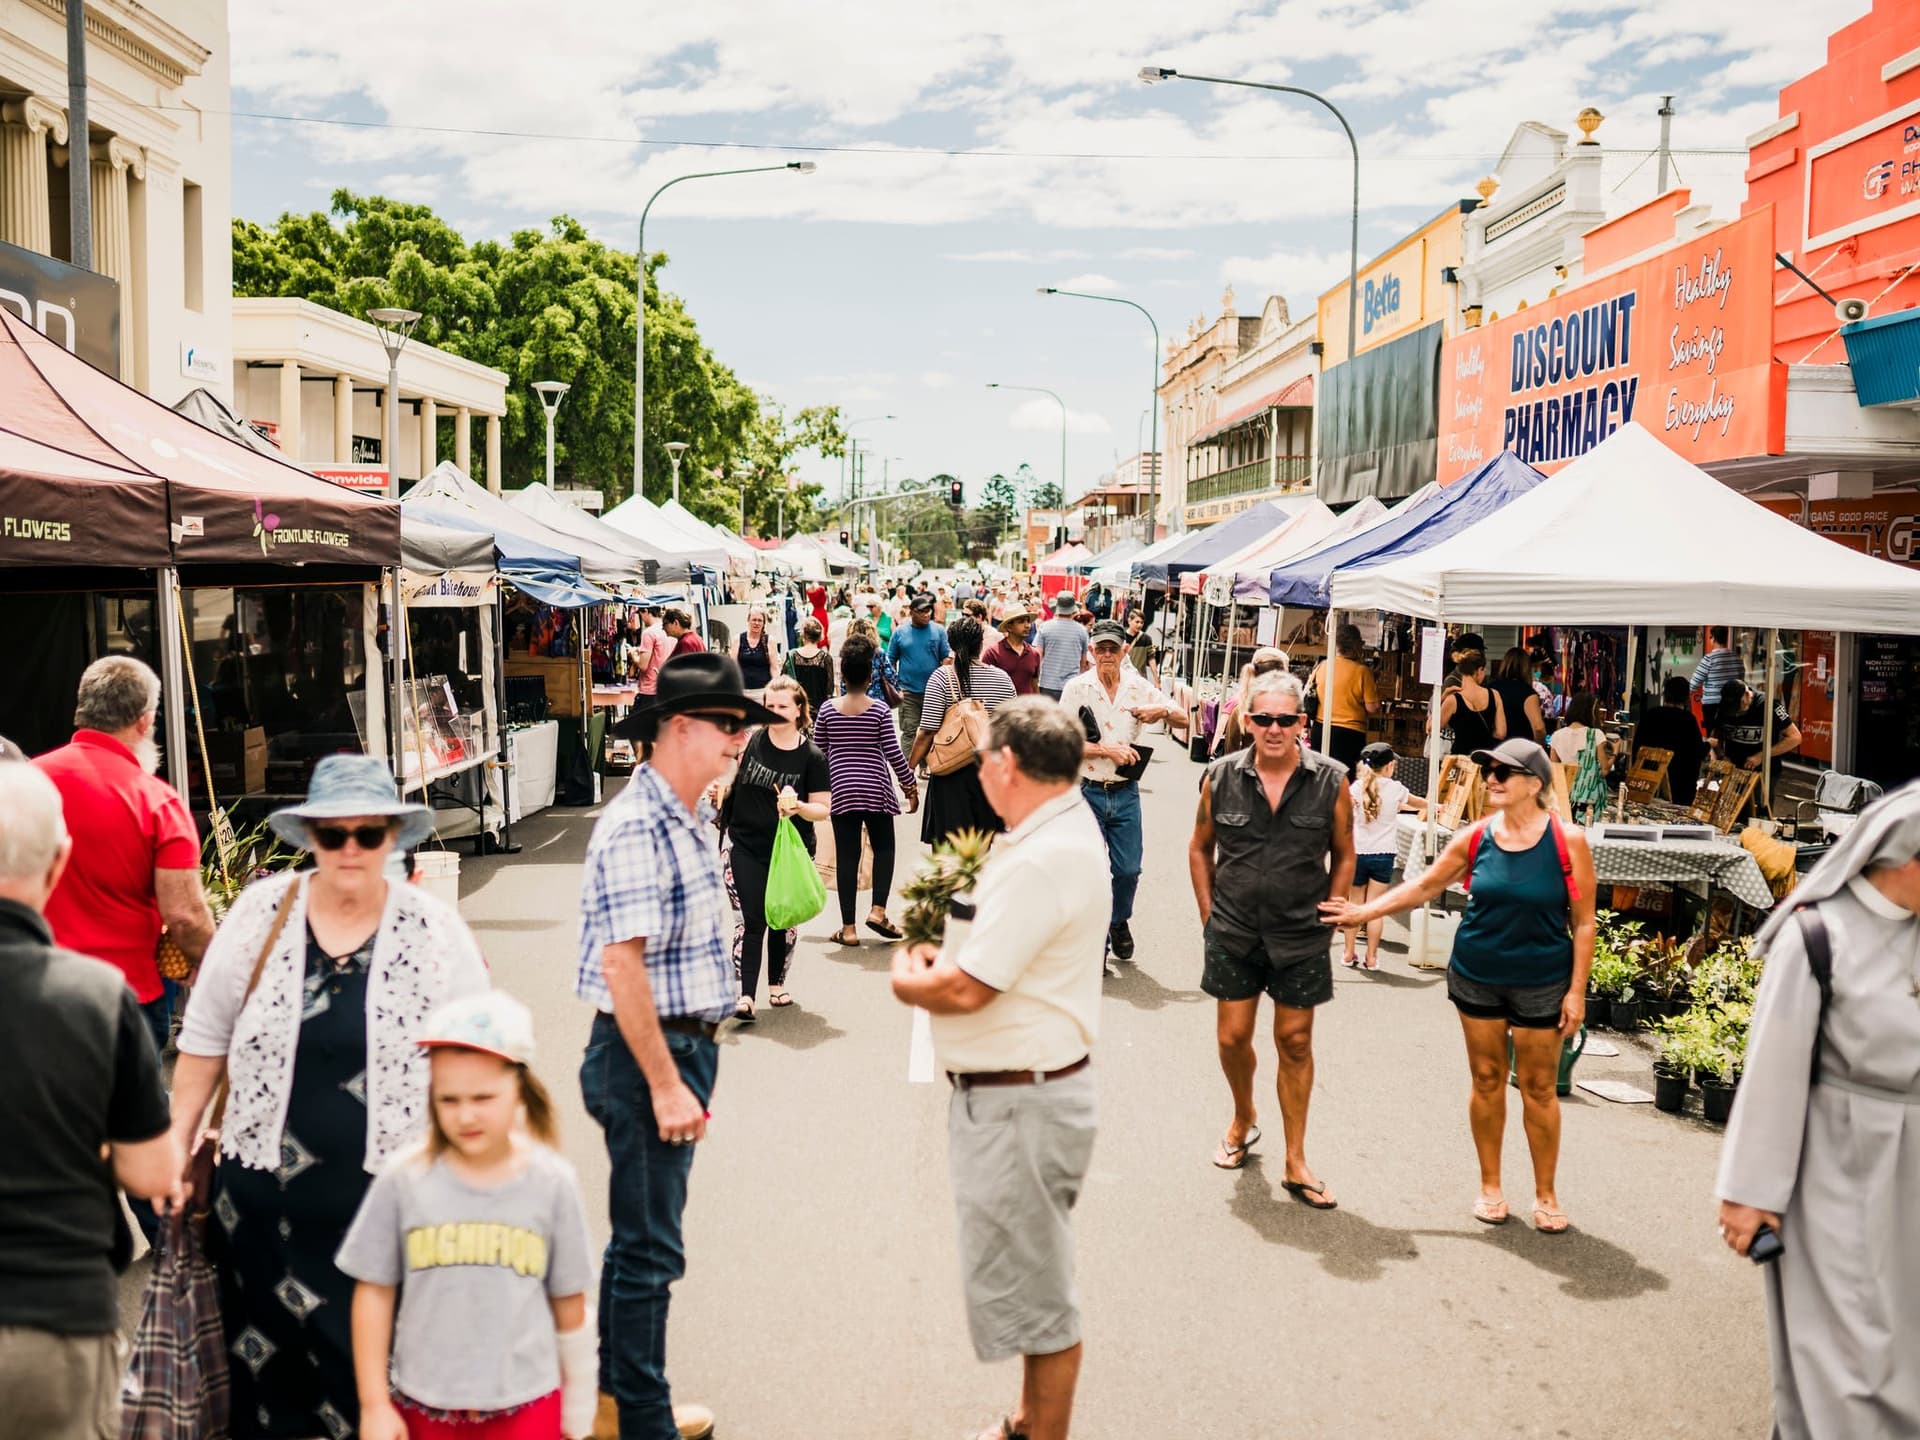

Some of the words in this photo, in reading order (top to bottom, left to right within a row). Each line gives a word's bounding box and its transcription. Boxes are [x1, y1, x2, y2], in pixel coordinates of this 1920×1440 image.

[1363, 272, 1400, 335] Betta
[1674, 248, 1732, 312] Healthy
[1510, 291, 1636, 393] DISCOUNT
[1669, 323, 1724, 375] Savings
[1503, 376, 1638, 464] PHARMACY
[1665, 377, 1735, 442] Everyday
[4, 517, 71, 541] FLOWERS
[273, 529, 314, 544] FRONTLINE
[315, 531, 349, 547] FLOWERS
[1839, 512, 1861, 521] GOOD
[1863, 511, 1889, 521] PRICE
